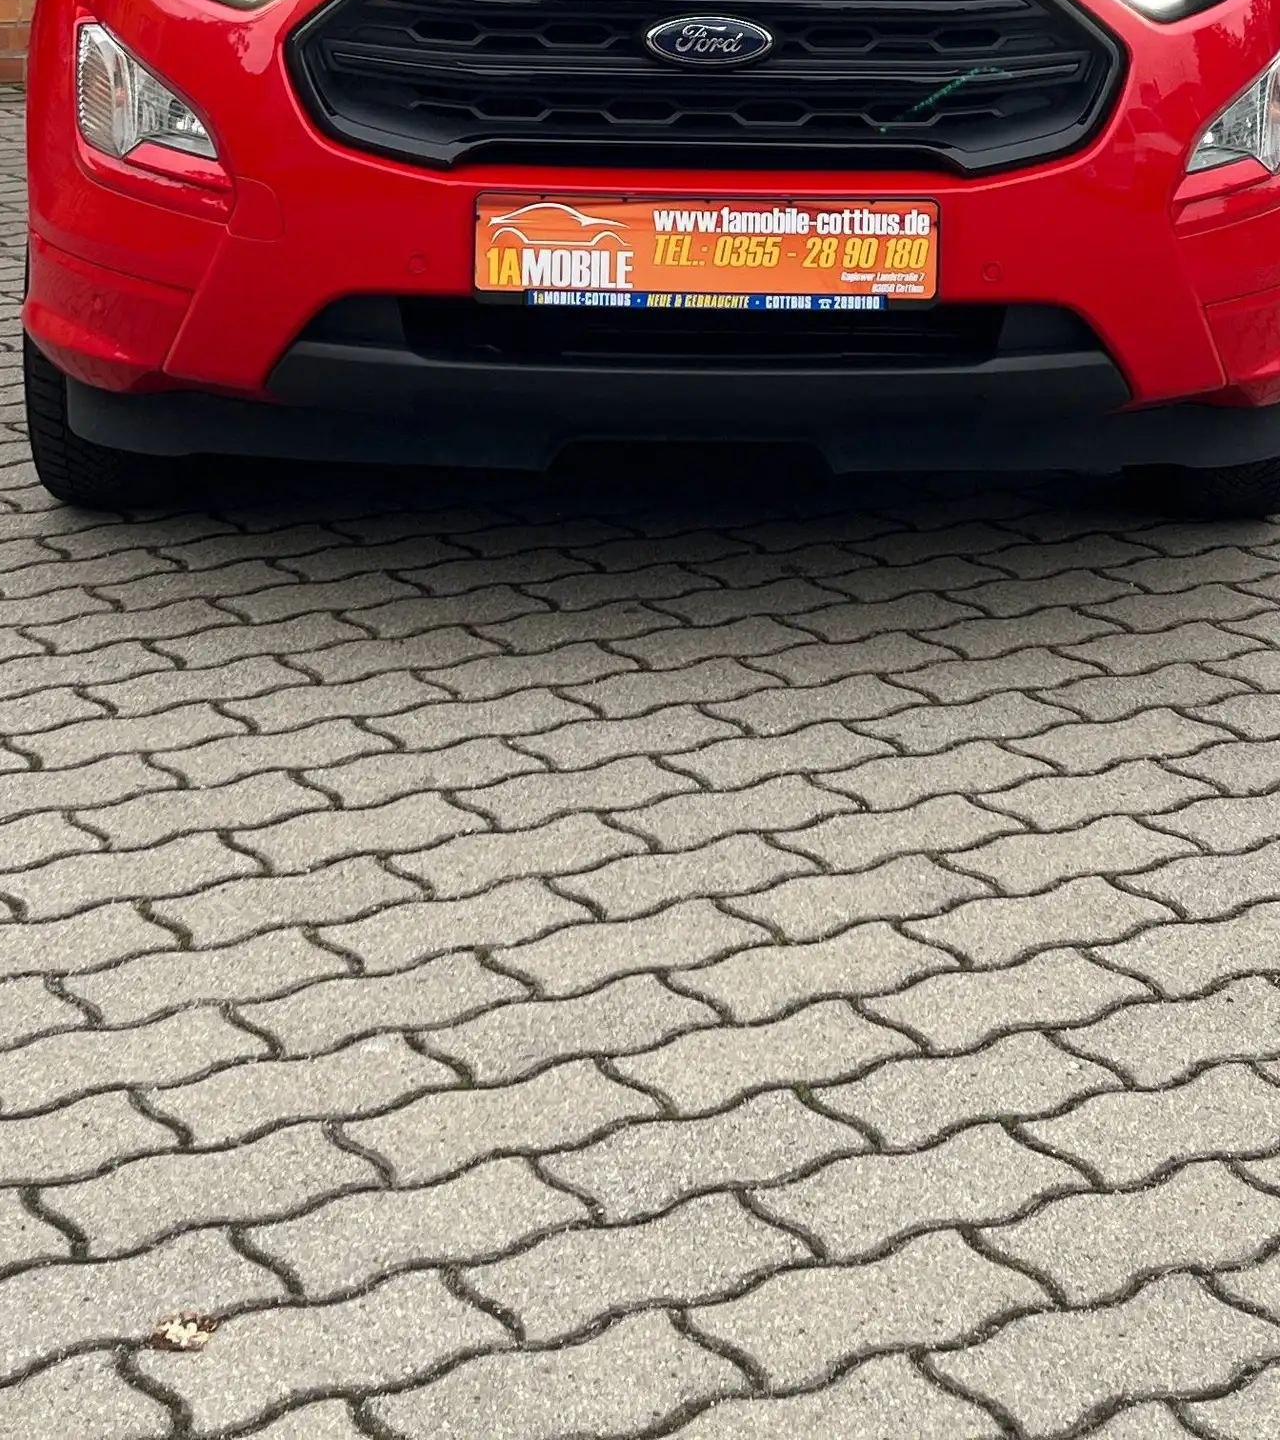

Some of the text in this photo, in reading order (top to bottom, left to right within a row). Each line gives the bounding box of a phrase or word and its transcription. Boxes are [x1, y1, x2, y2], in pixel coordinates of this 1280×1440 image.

[675, 24, 744, 52] Ford
[653, 206, 930, 235] www.1amobile-cottbus.de
[713, 235, 782, 267] 0355
[802, 237, 838, 268] 28
[842, 237, 879, 268] 90
[884, 238, 929, 269] 180
[486, 247, 634, 289] 1AMOBILE
[646, 293, 673, 308] NEUE
[684, 294, 750, 309] GEBRAUCHTE
[765, 295, 812, 310] COTTBUS
